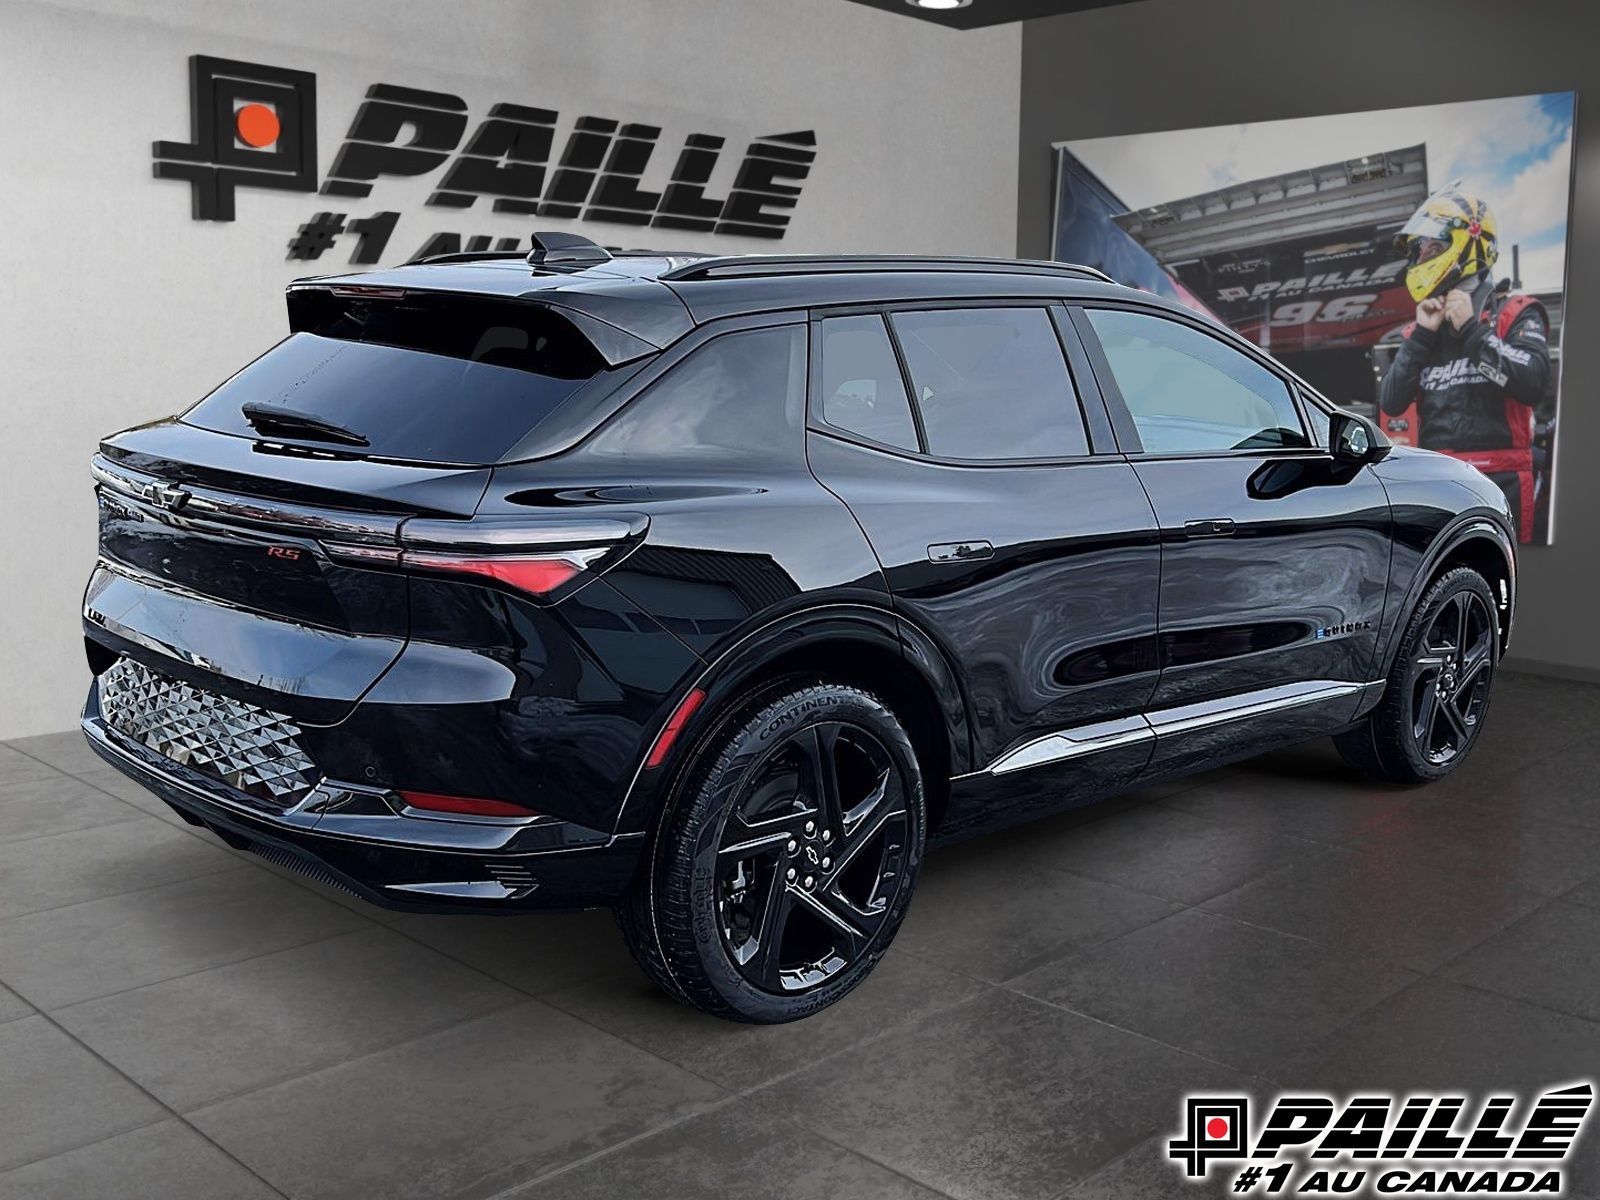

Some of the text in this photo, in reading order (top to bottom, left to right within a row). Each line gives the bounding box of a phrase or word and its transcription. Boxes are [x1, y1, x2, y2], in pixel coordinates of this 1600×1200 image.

[319, 82, 817, 240] PAILLÉ
[285, 211, 402, 264] #1
[1269, 294, 1379, 328] 96
[267, 545, 300, 560] RS
